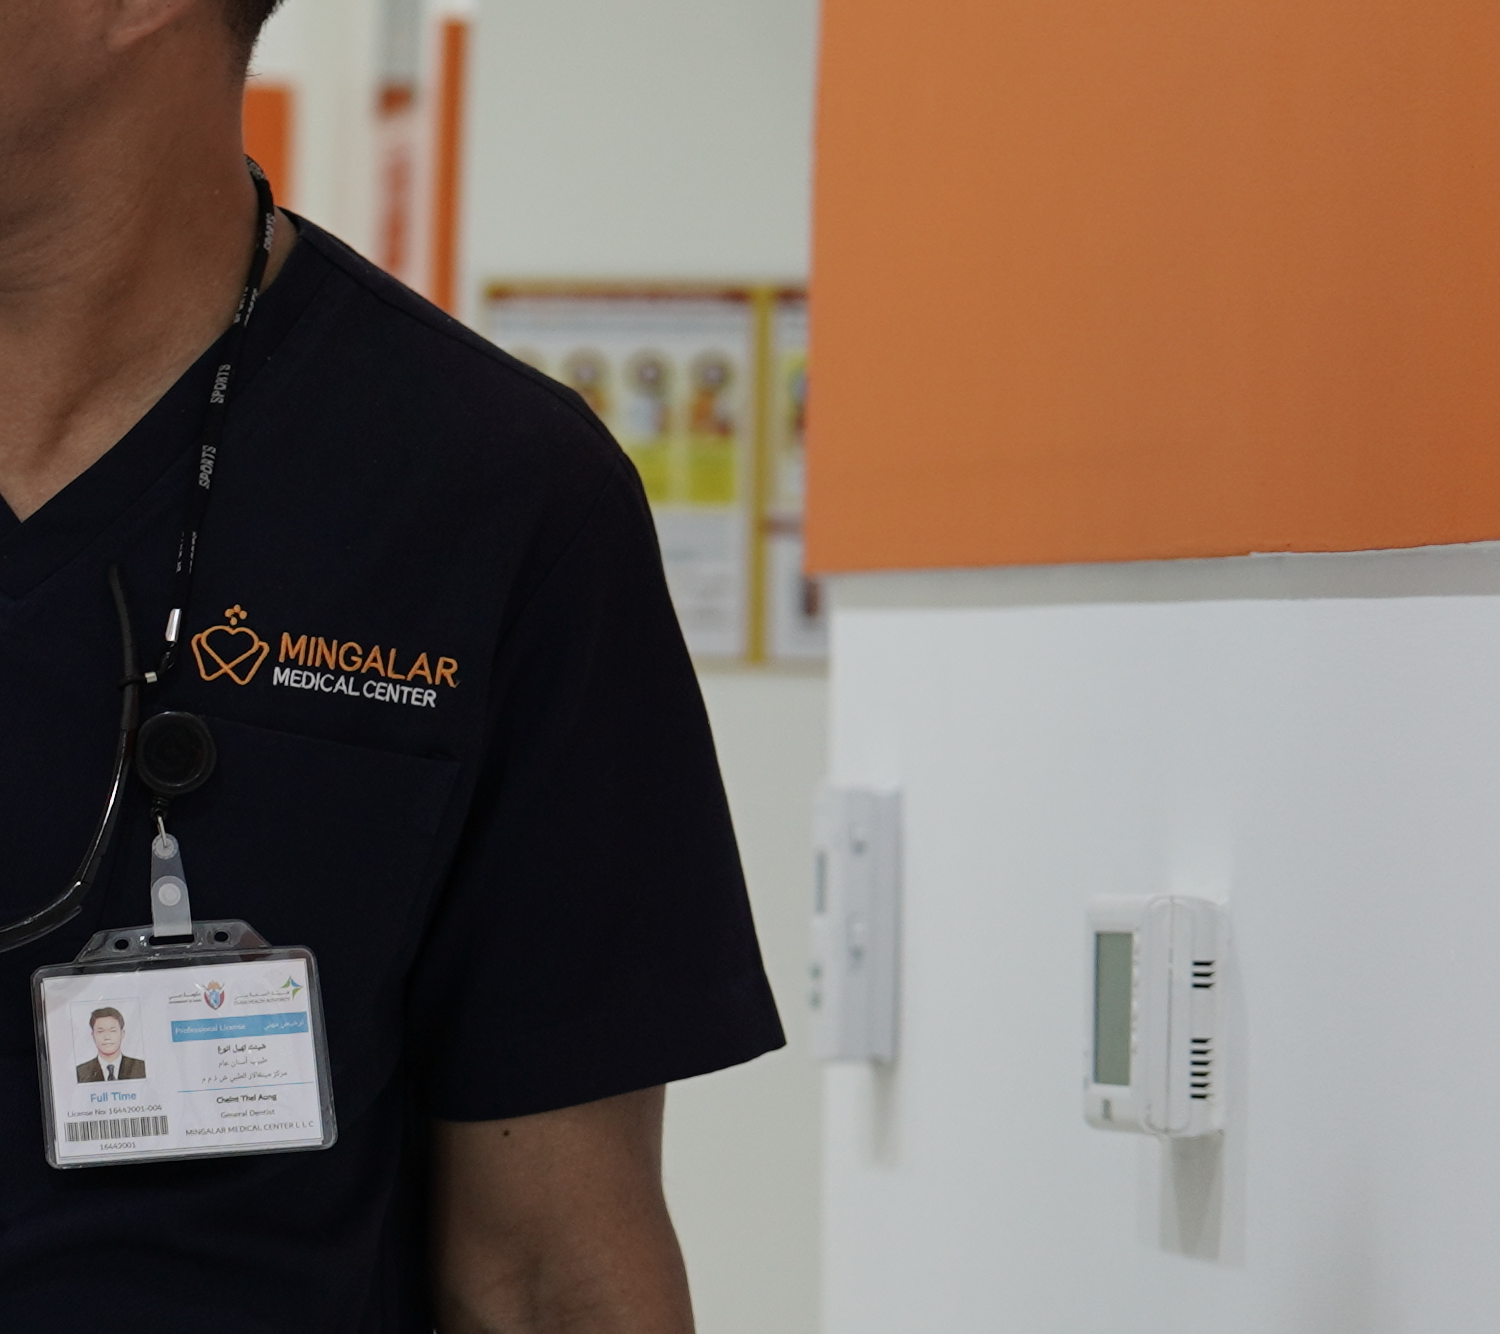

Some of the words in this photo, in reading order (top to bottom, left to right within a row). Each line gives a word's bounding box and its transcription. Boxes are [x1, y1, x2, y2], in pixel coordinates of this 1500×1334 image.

[210, 364, 231, 404] SPORTS
[198, 445, 217, 489] SPORTS
[278, 632, 459, 688] MINGALAR
[272, 666, 360, 697] MEDICAL
[362, 680, 437, 708] CENTER
[175, 1025, 218, 1034] Professional
[90, 1092, 108, 1103] Full
[110, 1091, 137, 1101] Time
[67, 1110, 94, 1118] License
[220, 1110, 248, 1118] General
[249, 1108, 275, 1117] Dentist
[185, 1127, 226, 1136] MINGALAR
[228, 1124, 262, 1133] MEDICAL
[263, 1122, 294, 1131] CENTER
